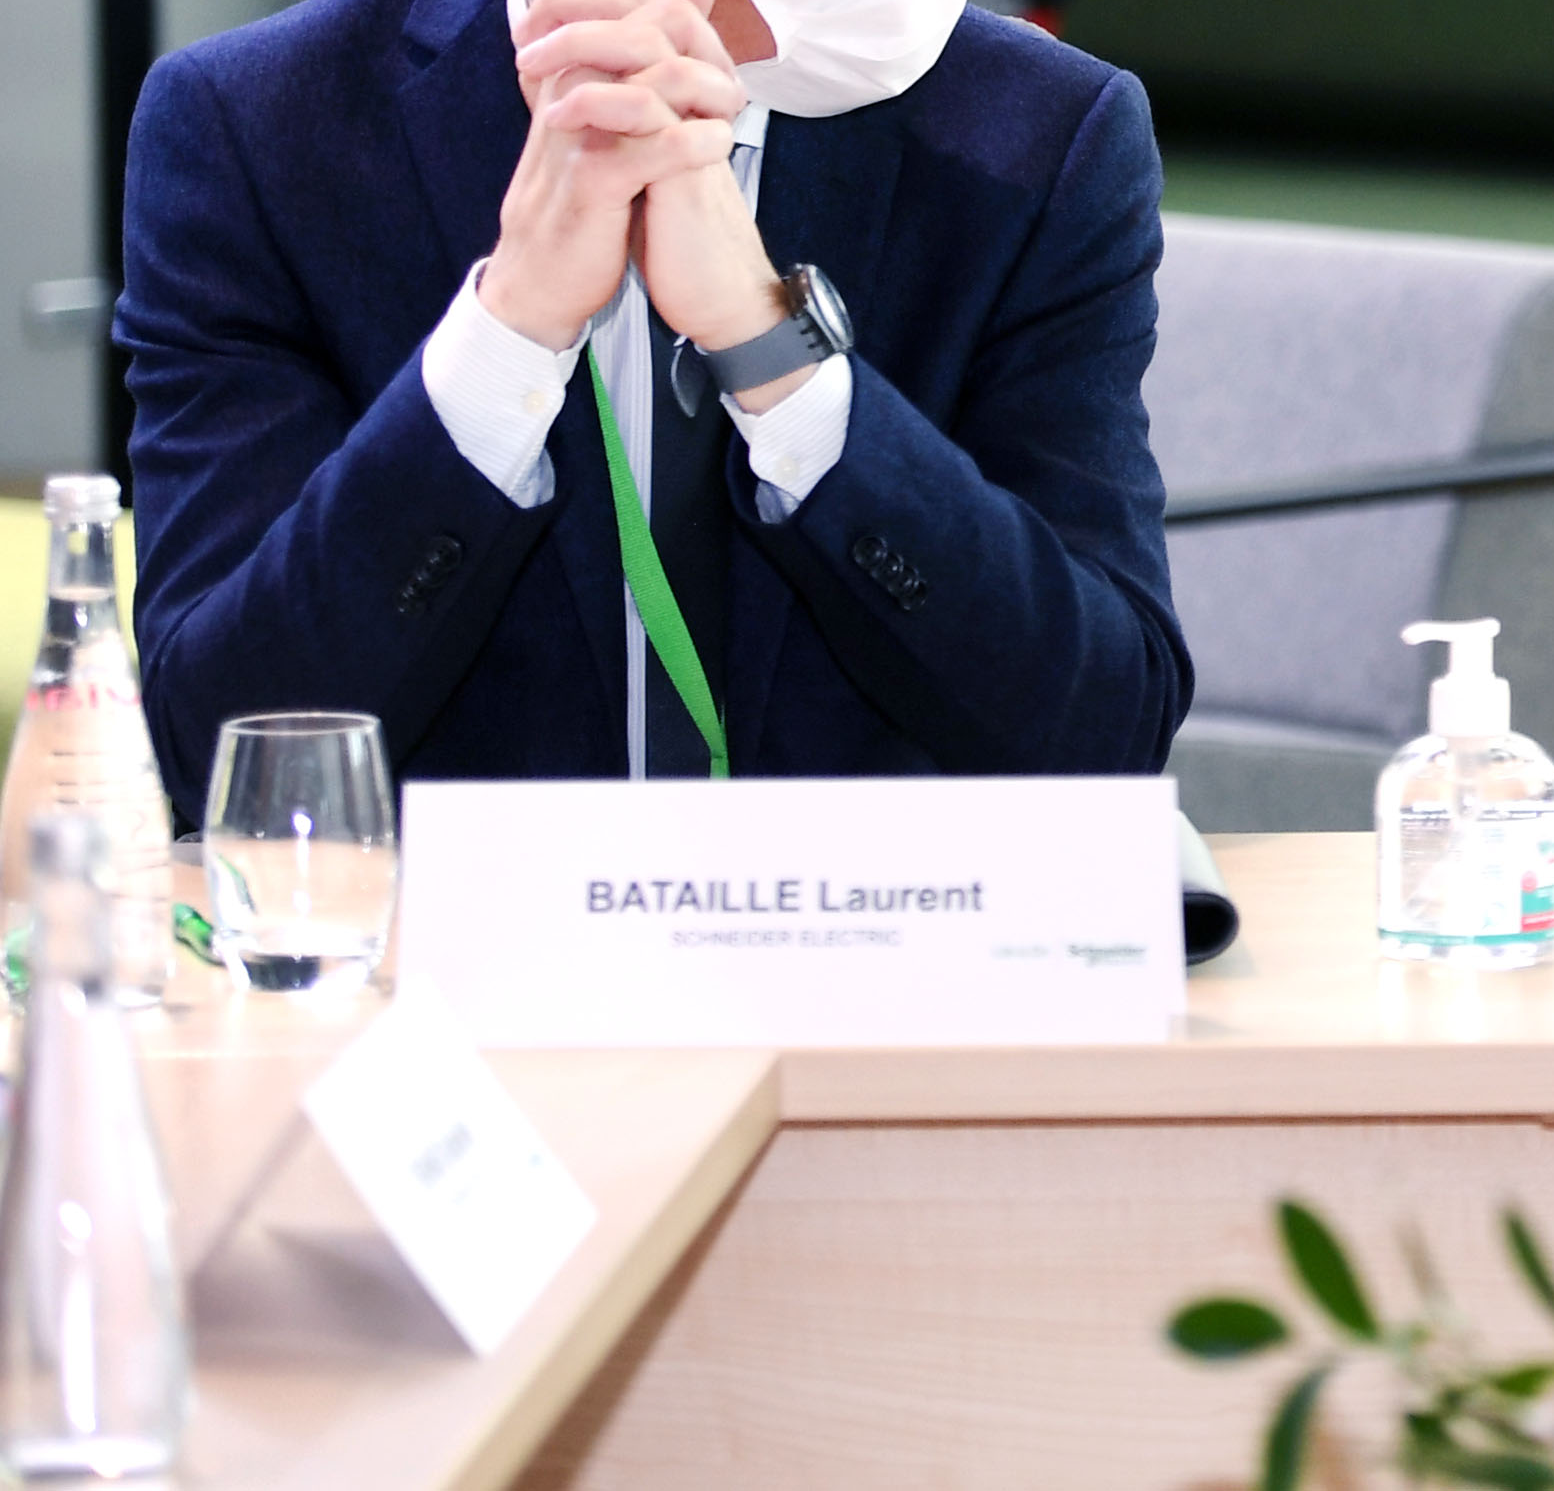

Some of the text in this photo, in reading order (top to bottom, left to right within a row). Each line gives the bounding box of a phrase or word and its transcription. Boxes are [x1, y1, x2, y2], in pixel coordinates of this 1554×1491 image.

[586, 879, 984, 913] BATAILLE Laurent
[672, 929, 899, 947] SCHNEIDER ELECTRIC
